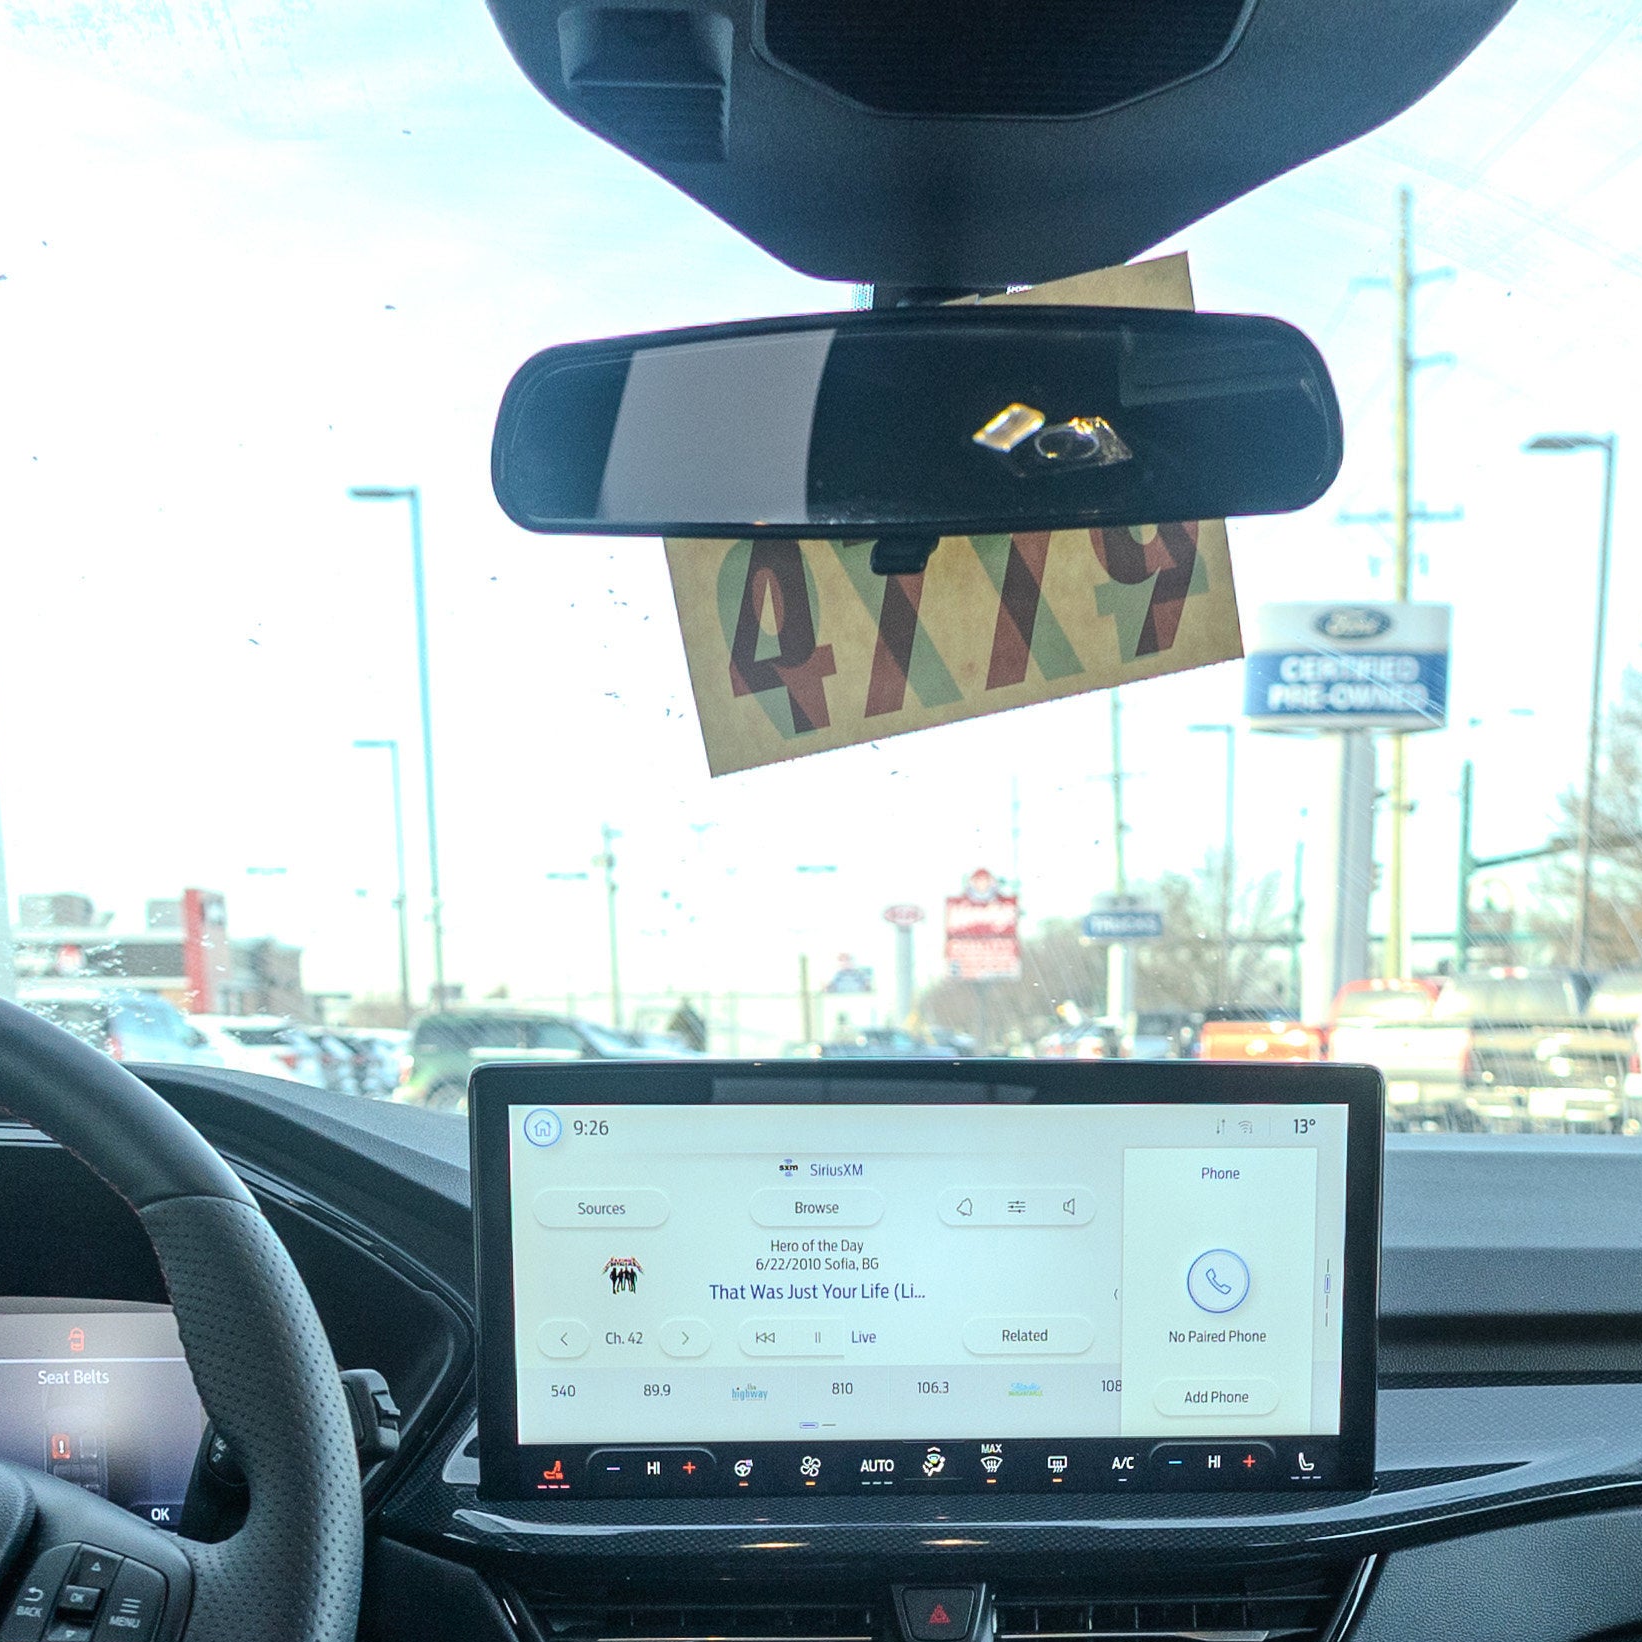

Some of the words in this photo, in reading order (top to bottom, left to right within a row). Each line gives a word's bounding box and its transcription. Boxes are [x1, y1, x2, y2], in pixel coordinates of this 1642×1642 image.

[1280, 655, 1420, 683] CERTIFIED
[1268, 682, 1429, 711] PRE-OWNED
[573, 1120, 609, 1136] 9:26
[1293, 1118, 1316, 1134] 13°
[809, 1163, 863, 1177] SiriusXM
[1201, 1167, 1240, 1180] Phone
[577, 1201, 626, 1215] Sources
[794, 1201, 839, 1214] Browse
[770, 1240, 799, 1252] Hero
[801, 1239, 815, 1252] of
[818, 1239, 838, 1252] the
[841, 1239, 864, 1254] Day
[755, 1258, 821, 1271] 6/22/2010
[824, 1257, 859, 1272] Sofia,
[862, 1257, 879, 1270] BG
[709, 1284, 746, 1300] That
[750, 1284, 784, 1300] Was
[787, 1284, 818, 1300] Just
[822, 1283, 858, 1299] Your
[861, 1283, 890, 1299] Life
[894, 1282, 926, 1301] (Li...
[605, 1331, 625, 1345] Ch.
[627, 1331, 643, 1345] 42
[851, 1330, 877, 1344] Live
[1001, 1329, 1049, 1343] Related
[1168, 1331, 1185, 1343] No
[1188, 1330, 1225, 1343] Paired
[1229, 1330, 1267, 1342] Phone
[37, 1369, 71, 1385] Seat
[74, 1369, 110, 1385] Belts
[551, 1384, 576, 1397] 540
[643, 1383, 671, 1397] 89.9
[831, 1382, 854, 1395] 810
[917, 1381, 950, 1395] 106.3
[1101, 1379, 1122, 1392] 108
[731, 1387, 768, 1401] highway
[1184, 1391, 1208, 1404] Add
[1211, 1390, 1249, 1403] Phone
[981, 1443, 1003, 1454] MAX
[647, 1461, 661, 1475] HI
[860, 1459, 894, 1472] AUTO
[1111, 1456, 1135, 1470] A/C
[1208, 1455, 1221, 1469] HI
[151, 1508, 170, 1521] OK
[16, 1605, 42, 1618] BACK
[109, 1616, 141, 1629] MENU
